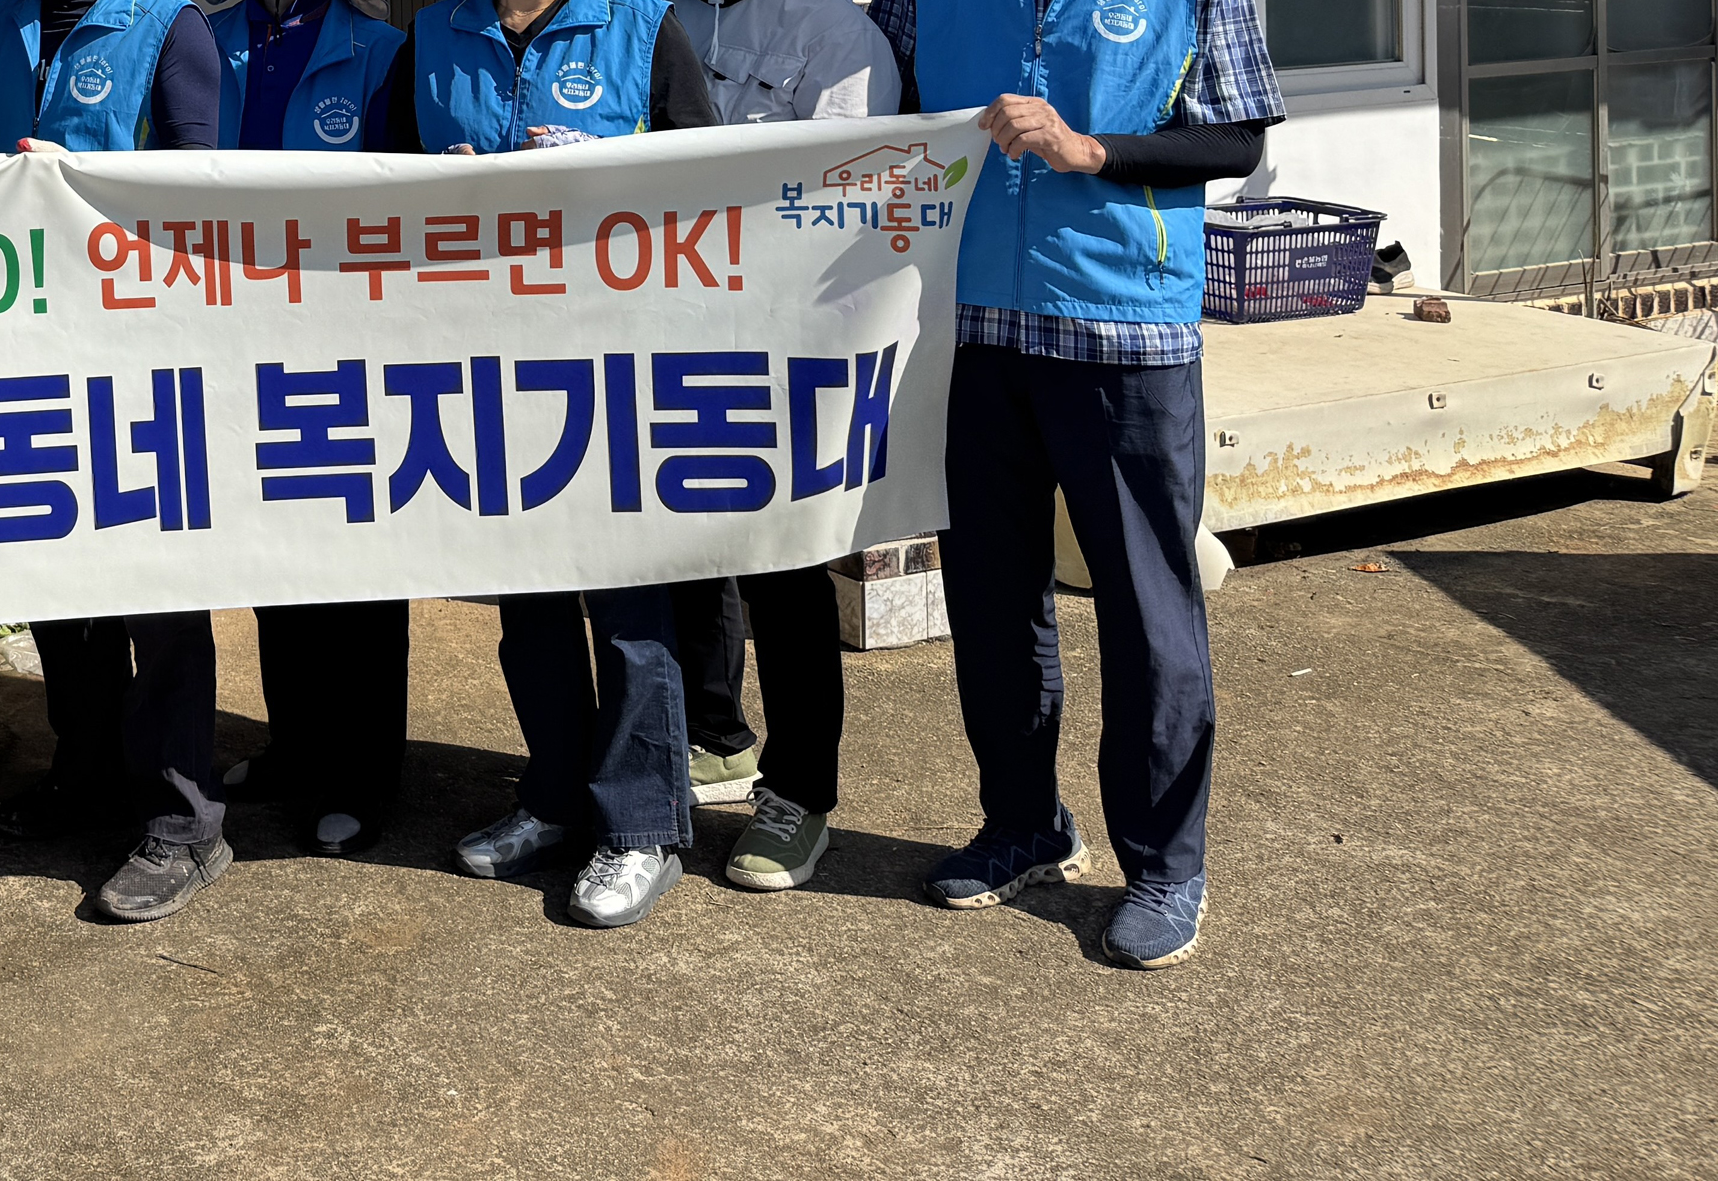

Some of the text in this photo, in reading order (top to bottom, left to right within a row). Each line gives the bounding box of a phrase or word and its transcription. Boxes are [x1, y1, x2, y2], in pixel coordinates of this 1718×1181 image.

[775, 181, 954, 254] 복지기동대
[831, 165, 939, 200] 우리동네
[87, 219, 312, 310] 언제나
[339, 209, 567, 302] 부르면
[595, 205, 744, 292] OK!
[256, 342, 899, 524] 복지기동대
